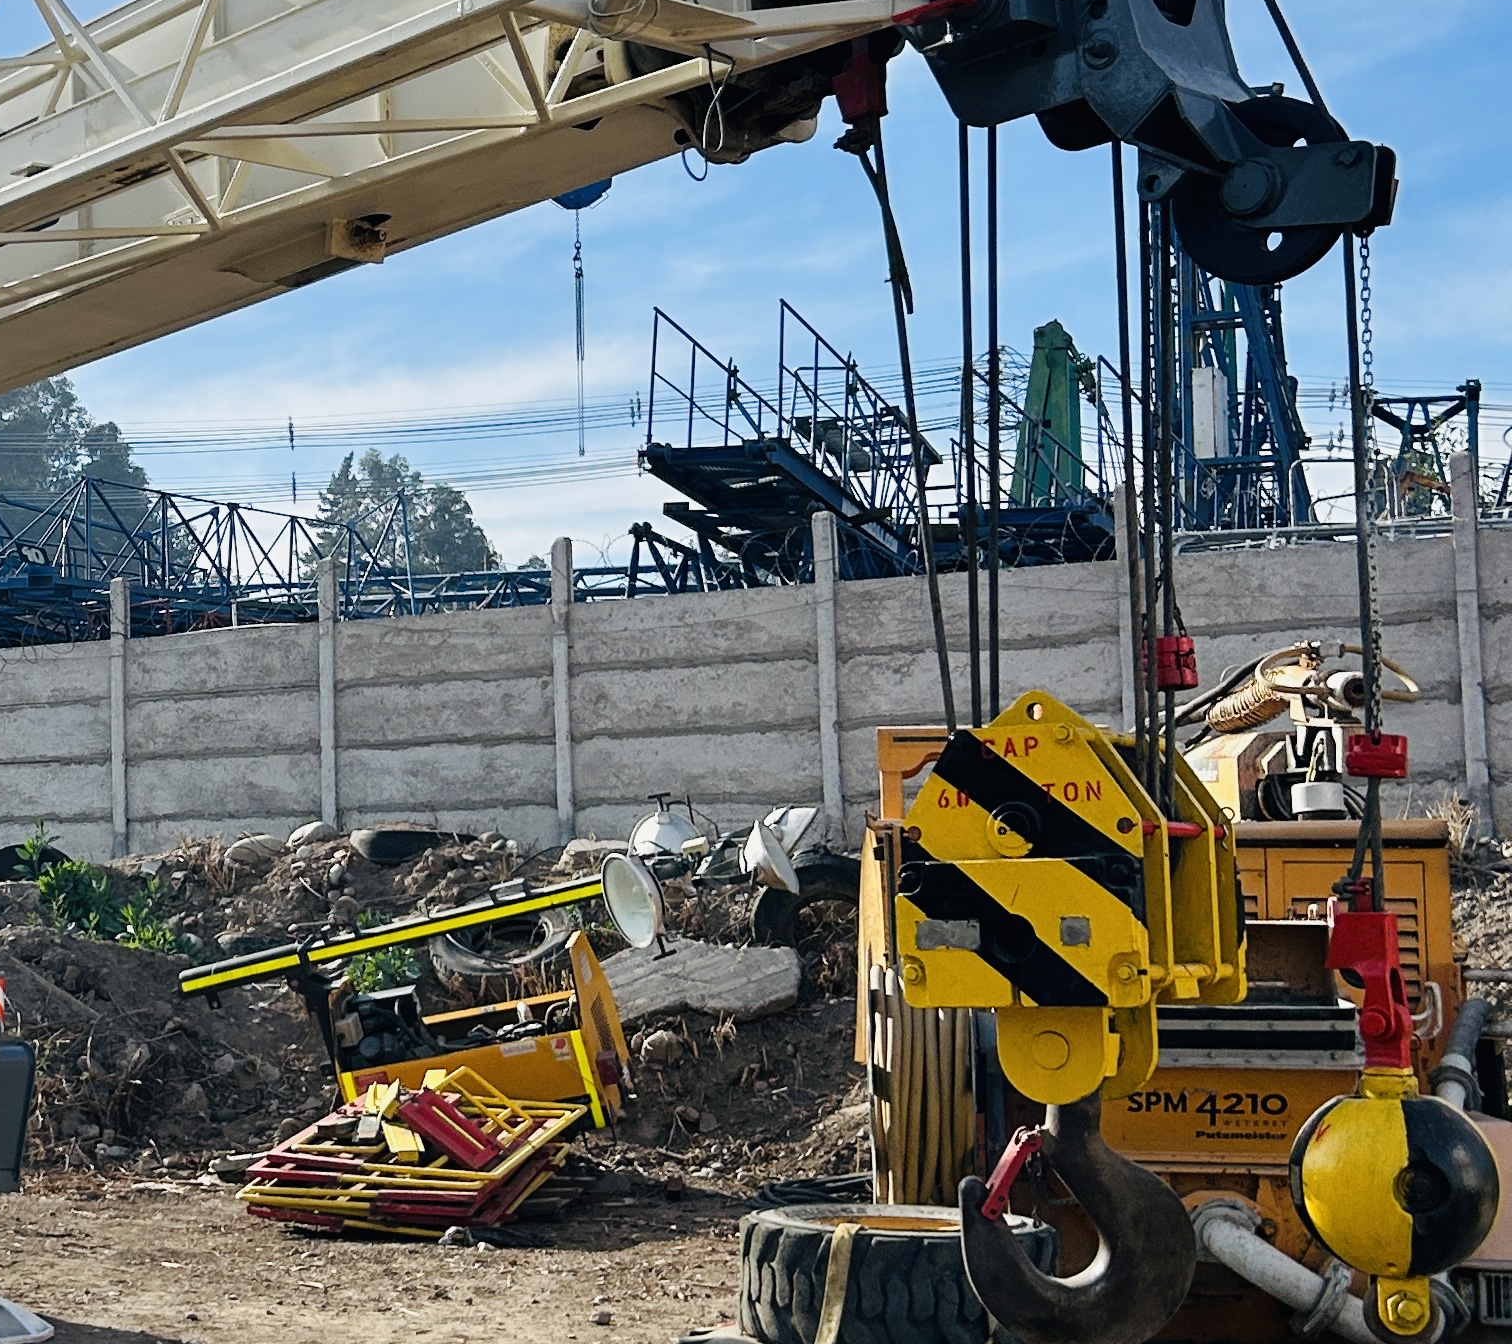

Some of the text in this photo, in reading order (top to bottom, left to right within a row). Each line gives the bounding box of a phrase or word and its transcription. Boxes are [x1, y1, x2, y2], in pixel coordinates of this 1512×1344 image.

[980, 736, 1039, 760] CAP
[1041, 779, 1103, 804] TON
[1126, 1091, 1288, 1127] SPM 4210
